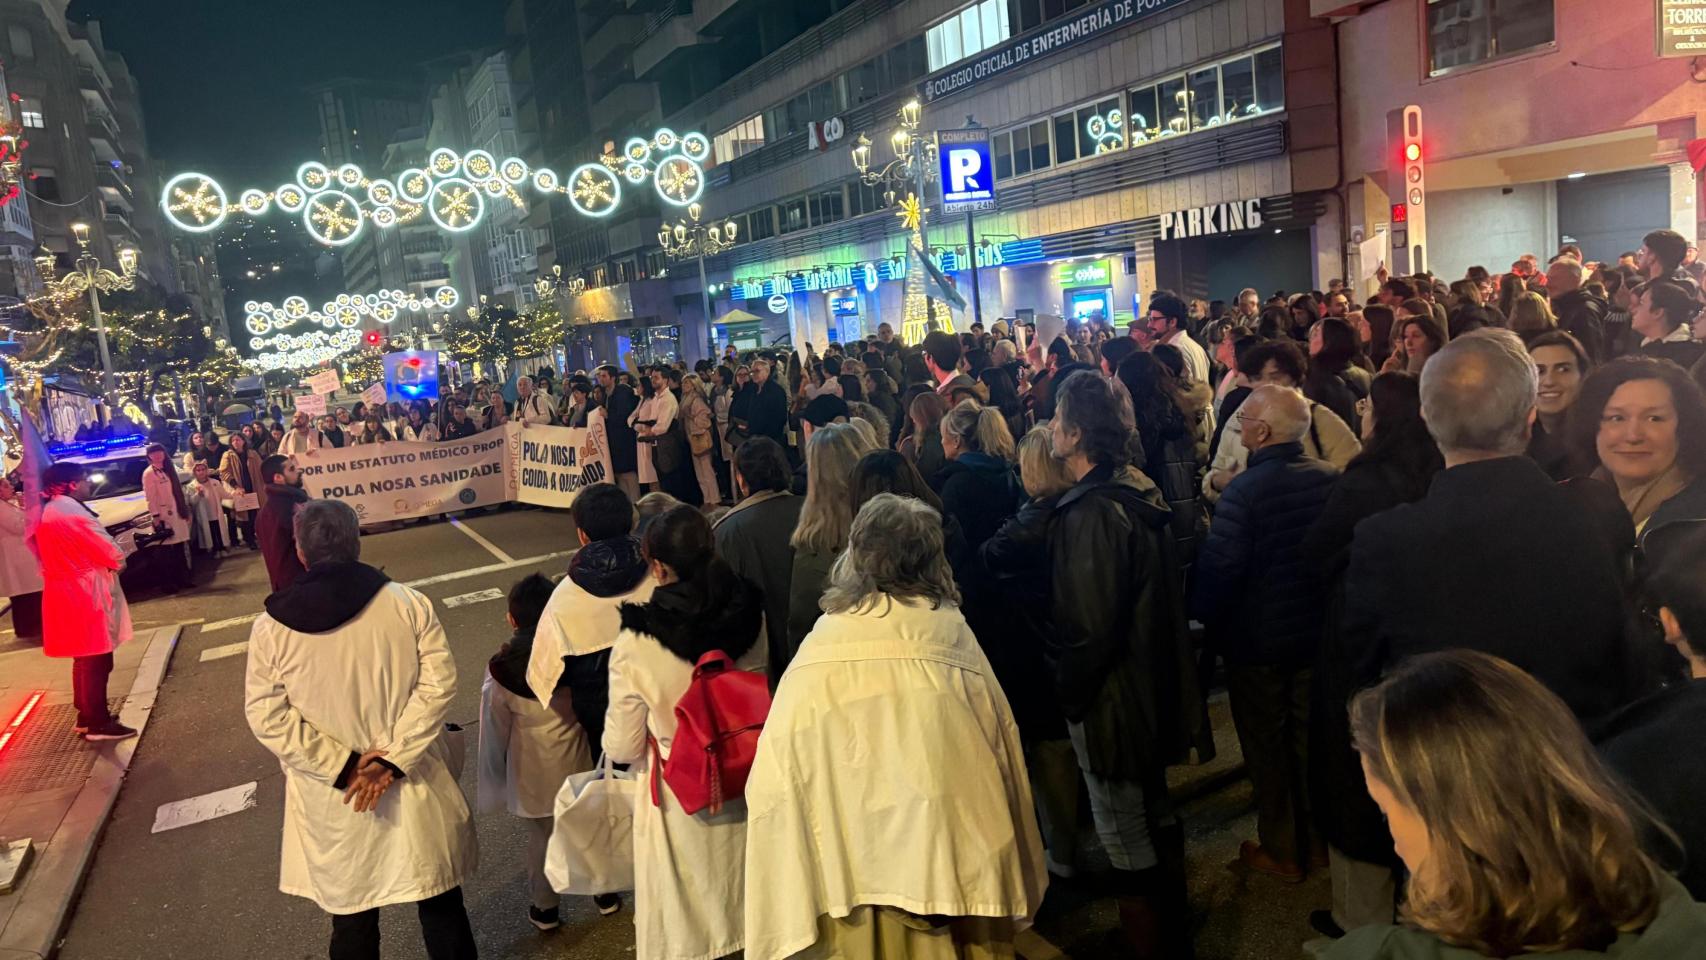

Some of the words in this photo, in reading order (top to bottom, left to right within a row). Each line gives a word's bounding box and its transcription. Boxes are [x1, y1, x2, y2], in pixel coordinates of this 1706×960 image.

[935, 67, 973, 96] COLEGIO
[974, 49, 1014, 79] OFICIAL
[1015, 42, 1030, 63] DE
[1031, 8, 1112, 56] ENFERMERÍA
[1114, 1, 1133, 22] DE
[1136, 0, 1165, 13] PO
[946, 203, 975, 212] Abierto
[976, 200, 994, 210] 24h
[1160, 198, 1262, 241] PARKING
[670, 326, 679, 337] R
[326, 461, 346, 473] UN
[349, 453, 416, 471] ESTATUTO
[419, 446, 470, 461] MÉDICO
[523, 441, 549, 464] POLA
[550, 444, 577, 467] NOSA
[322, 484, 366, 499] POLA
[369, 477, 416, 493] NOSA
[419, 462, 502, 487] SANIDADE
[522, 467, 549, 490] COIDA
[550, 471, 557, 491] A
